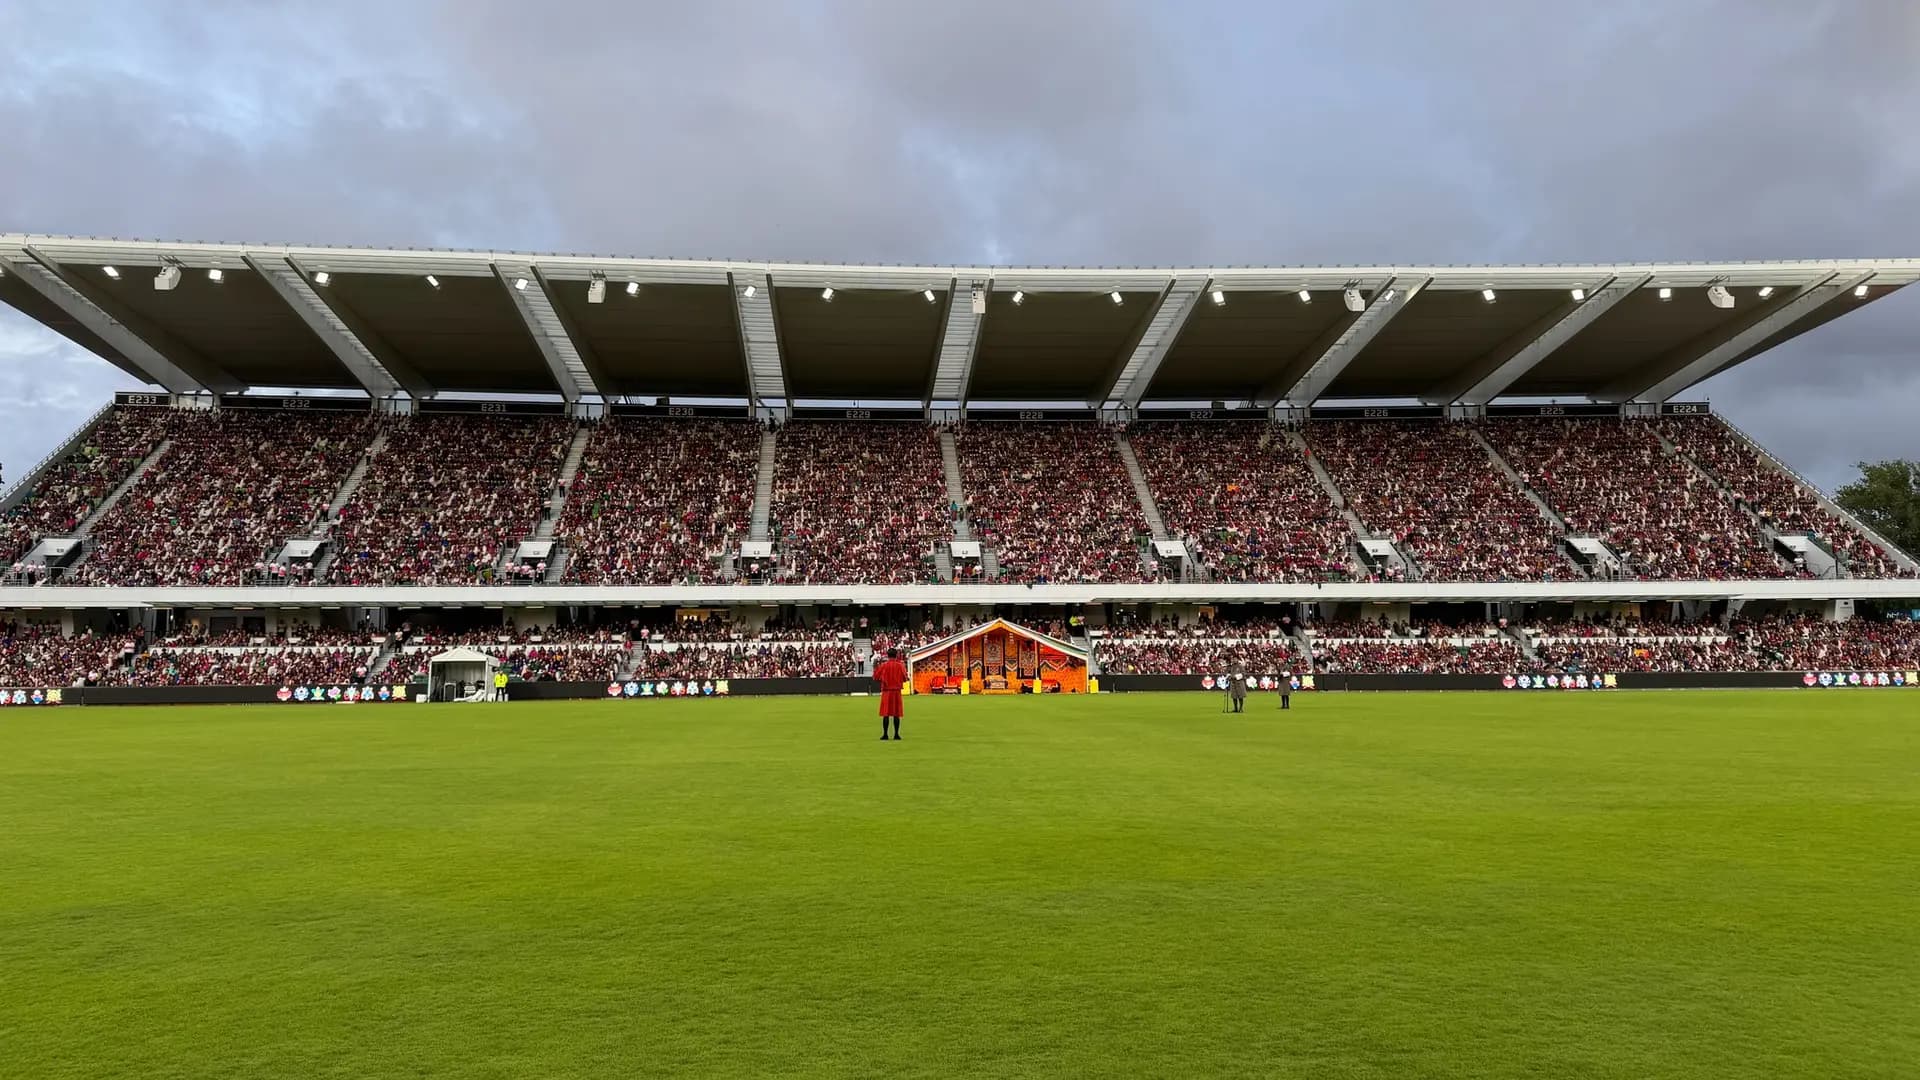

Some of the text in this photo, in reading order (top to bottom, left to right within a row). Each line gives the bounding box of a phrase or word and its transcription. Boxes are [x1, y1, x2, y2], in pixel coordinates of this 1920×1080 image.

[128, 395, 157, 404] E233
[282, 399, 310, 408] E232
[481, 403, 506, 412] E231
[669, 407, 694, 416] E230
[1540, 407, 1564, 415] E225
[1673, 404, 1697, 413] E224
[846, 410, 871, 419] E229
[1020, 411, 1043, 420] E228
[1190, 411, 1214, 419] E227
[1364, 409, 1388, 417] E226
